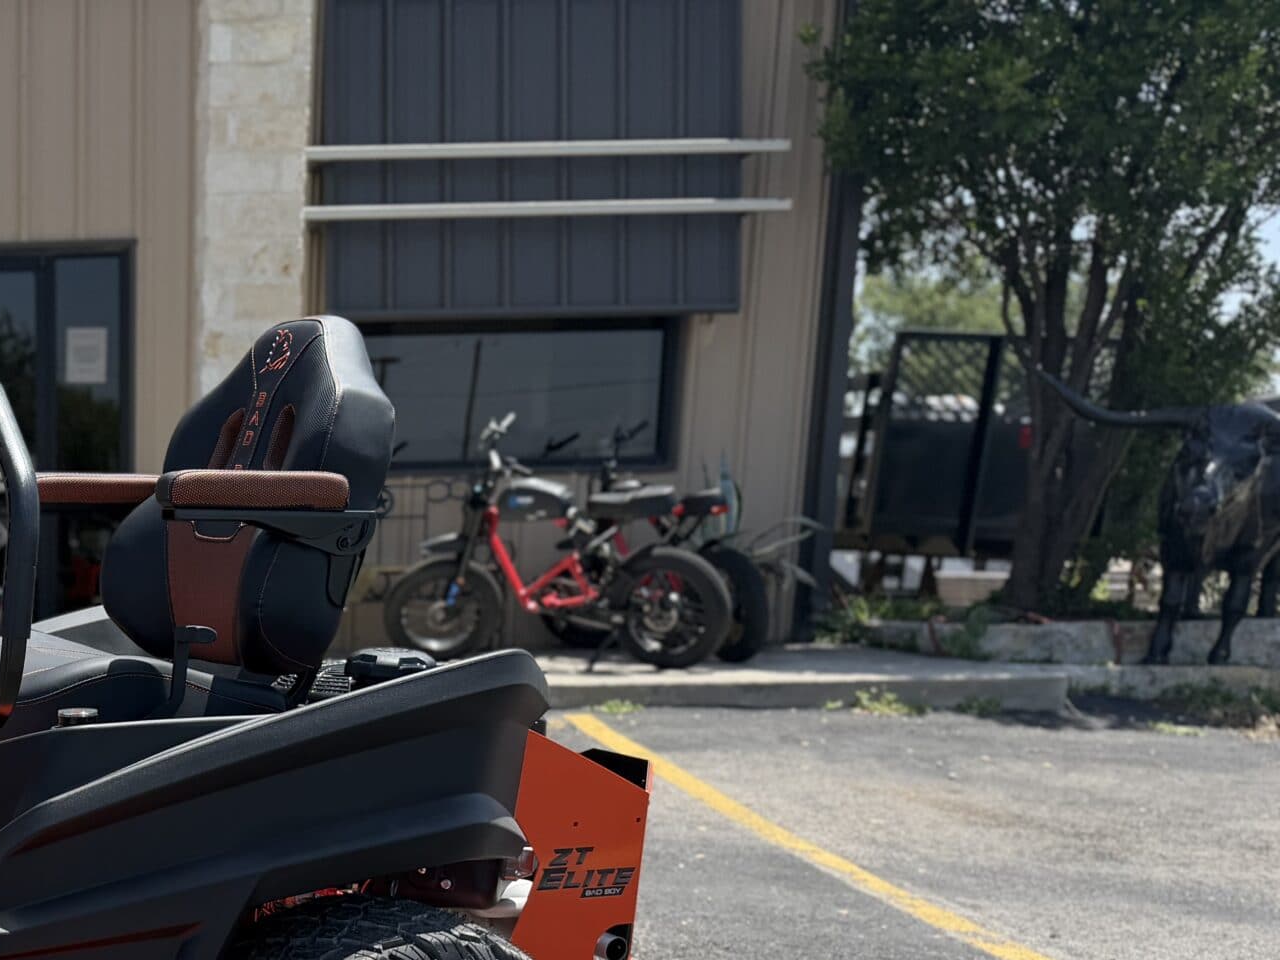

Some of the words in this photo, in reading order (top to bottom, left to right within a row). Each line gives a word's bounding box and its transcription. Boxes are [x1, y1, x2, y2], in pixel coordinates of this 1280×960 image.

[242, 391, 267, 446] BAD
[548, 846, 595, 867] ZT
[536, 866, 636, 891] ELITE
[584, 888, 603, 897] BAD
[604, 887, 622, 896] BOY
